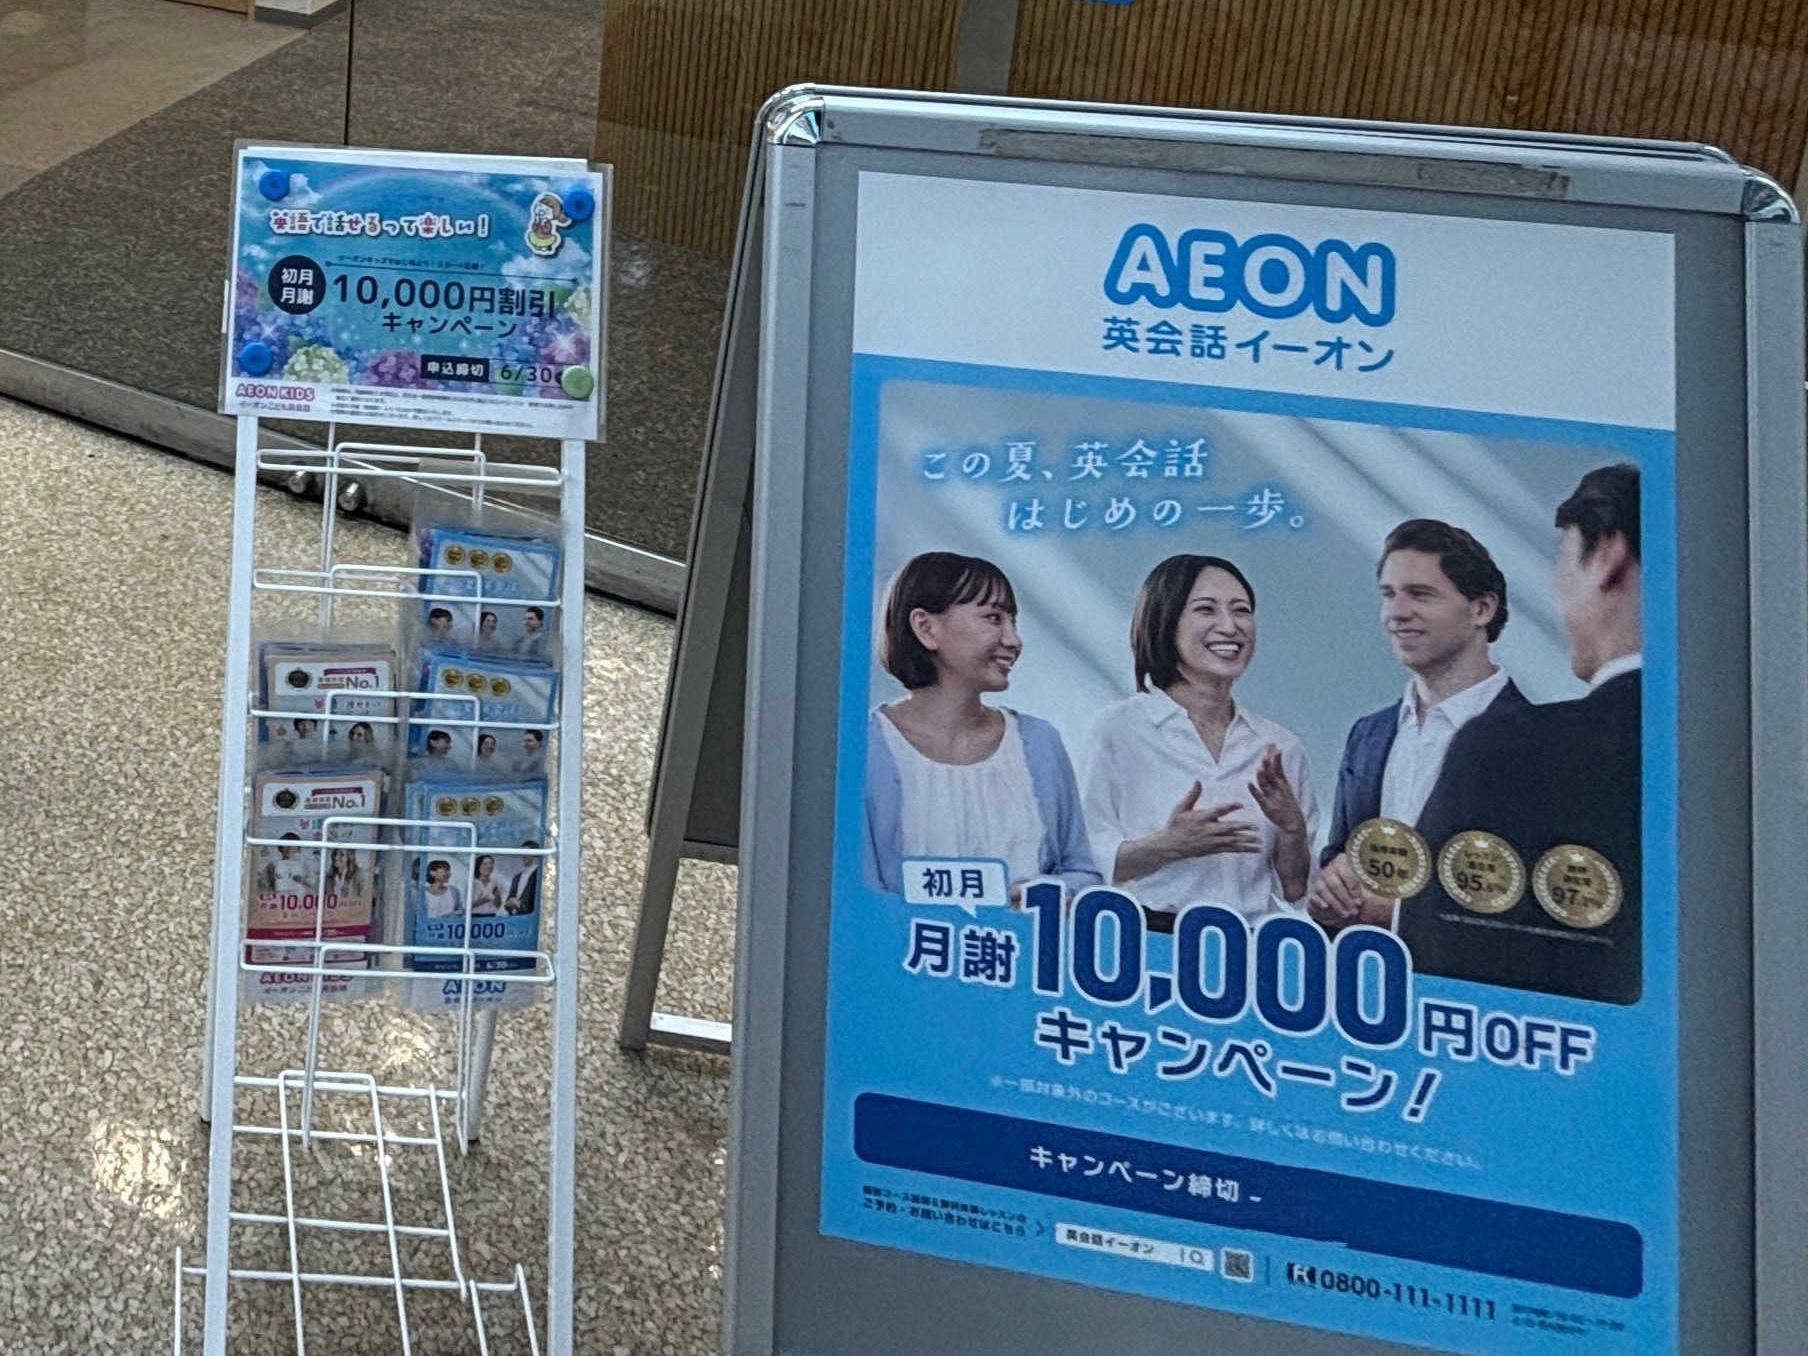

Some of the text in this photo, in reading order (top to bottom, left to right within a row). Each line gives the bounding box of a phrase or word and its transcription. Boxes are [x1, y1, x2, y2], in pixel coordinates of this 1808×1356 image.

[280, 267, 314, 286] 初月
[280, 287, 315, 306] 月謝
[332, 274, 556, 319] 10,000円割引
[1103, 223, 1396, 328] AEON
[381, 311, 519, 338] キャンペーン
[1102, 316, 1395, 373] 英会話イーオン
[426, 362, 486, 377] 申込締切
[499, 363, 553, 384] 6/30
[236, 383, 315, 402] AEON KIDS
[922, 438, 1210, 482] この夏、英会話
[1007, 488, 1309, 532] はじめの一歩。
[921, 866, 986, 900] 初月
[1033, 1004, 1444, 1127] キャンペーン!
[1029, 1144, 1241, 1204] キャンペーン締切
[1320, 1269, 1497, 1321] 0800-111-1111
